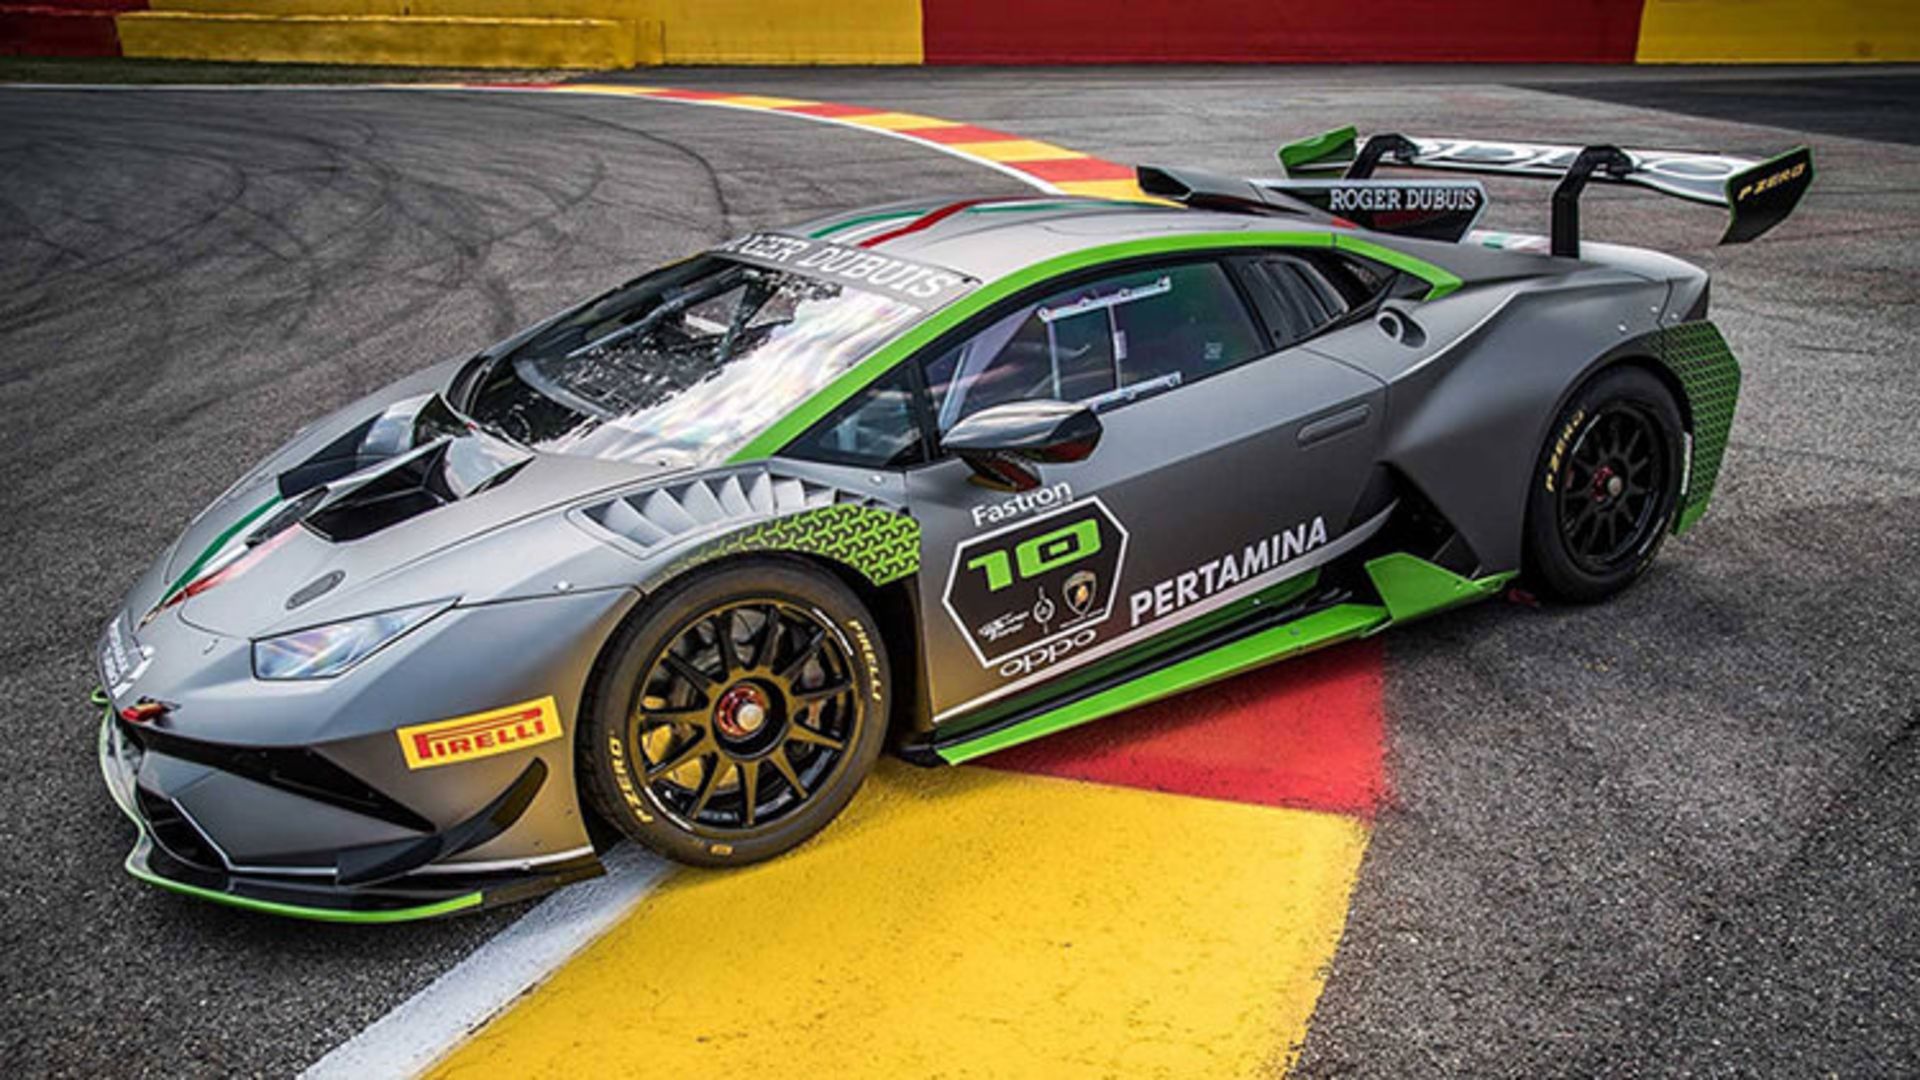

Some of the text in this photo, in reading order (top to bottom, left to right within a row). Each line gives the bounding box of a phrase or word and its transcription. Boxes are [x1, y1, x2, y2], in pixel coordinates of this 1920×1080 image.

[1329, 188, 1476, 211] ROGER DUBUIS
[797, 246, 955, 297] DUBUIS
[971, 480, 1073, 527] Fastron
[967, 518, 1102, 591] 10
[1128, 516, 1329, 627] PERTAMINA
[999, 628, 1097, 678] oppo
[413, 706, 546, 760] PIRELLI
